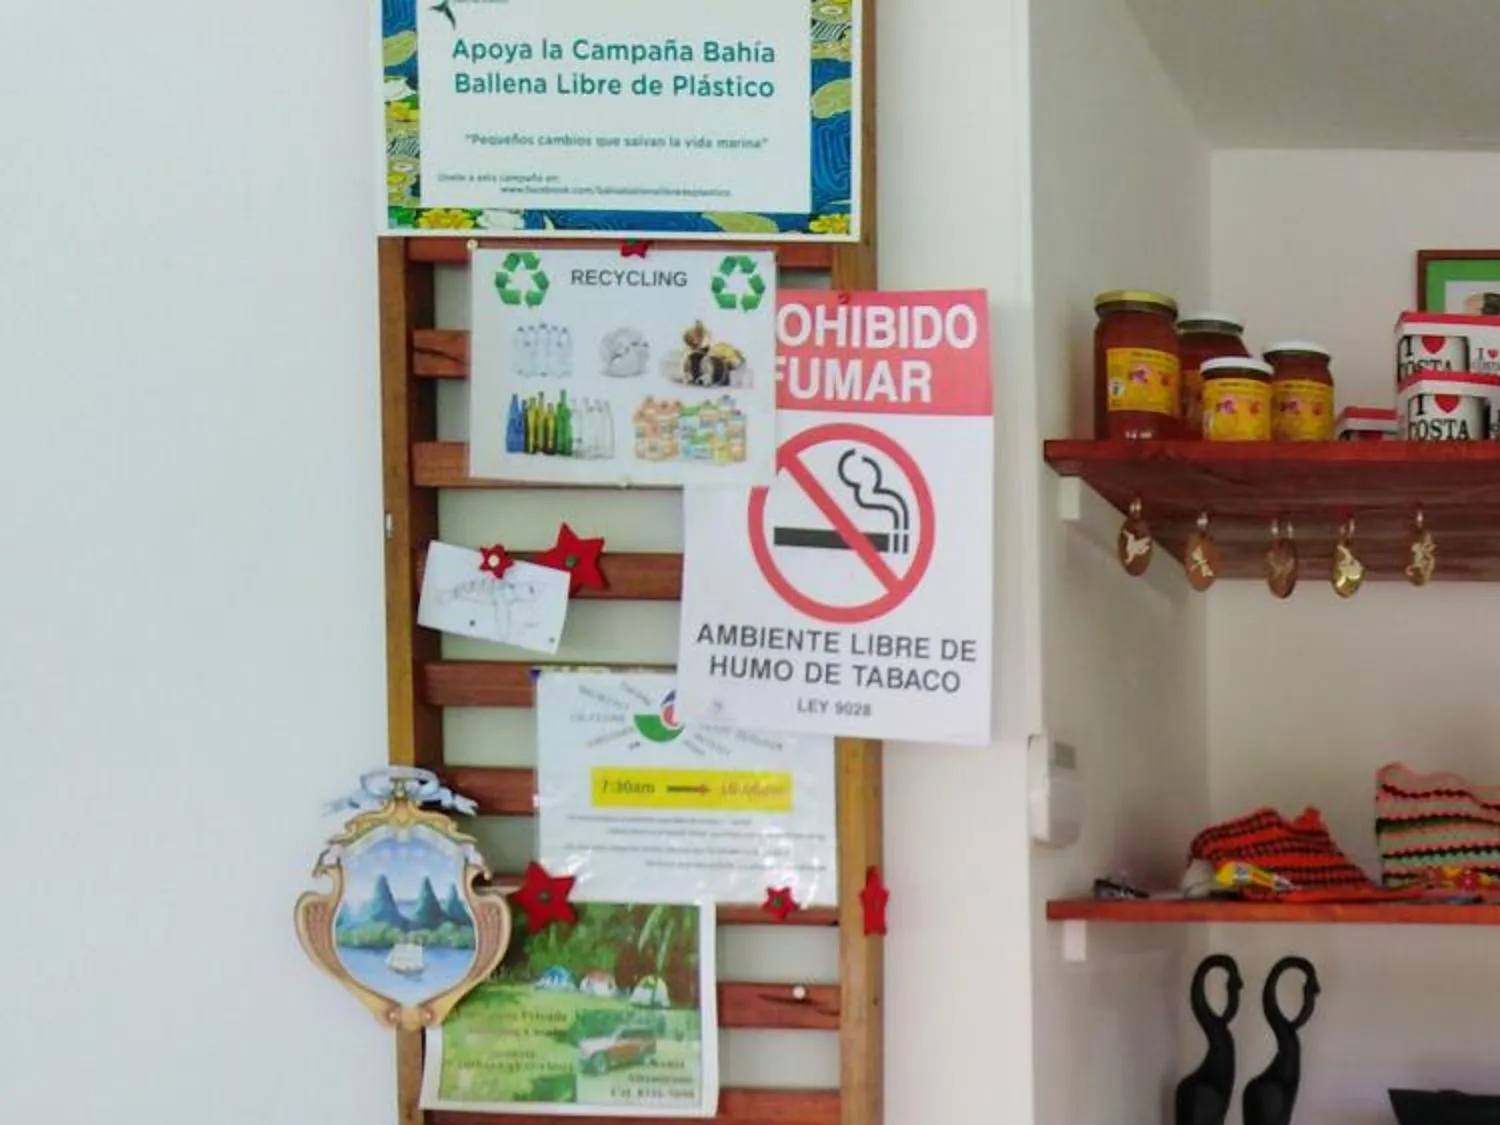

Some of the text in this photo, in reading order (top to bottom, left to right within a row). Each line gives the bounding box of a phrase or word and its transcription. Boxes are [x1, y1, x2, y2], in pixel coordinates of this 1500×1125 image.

[452, 37, 775, 64] Apoya la Campaña Bahía
[455, 72, 775, 97] Ballena Libre de Plástico
[538, 134, 592, 147] cambios
[596, 137, 620, 149] que
[670, 136, 681, 148] la
[685, 136, 712, 148] vida
[570, 269, 688, 288] RECYCLING
[776, 303, 978, 350] OHIBIDO
[697, 623, 977, 663] AMBIENTE LIBRE DE
[709, 655, 962, 694] HUMO DE TABACO
[797, 698, 829, 714] LEY
